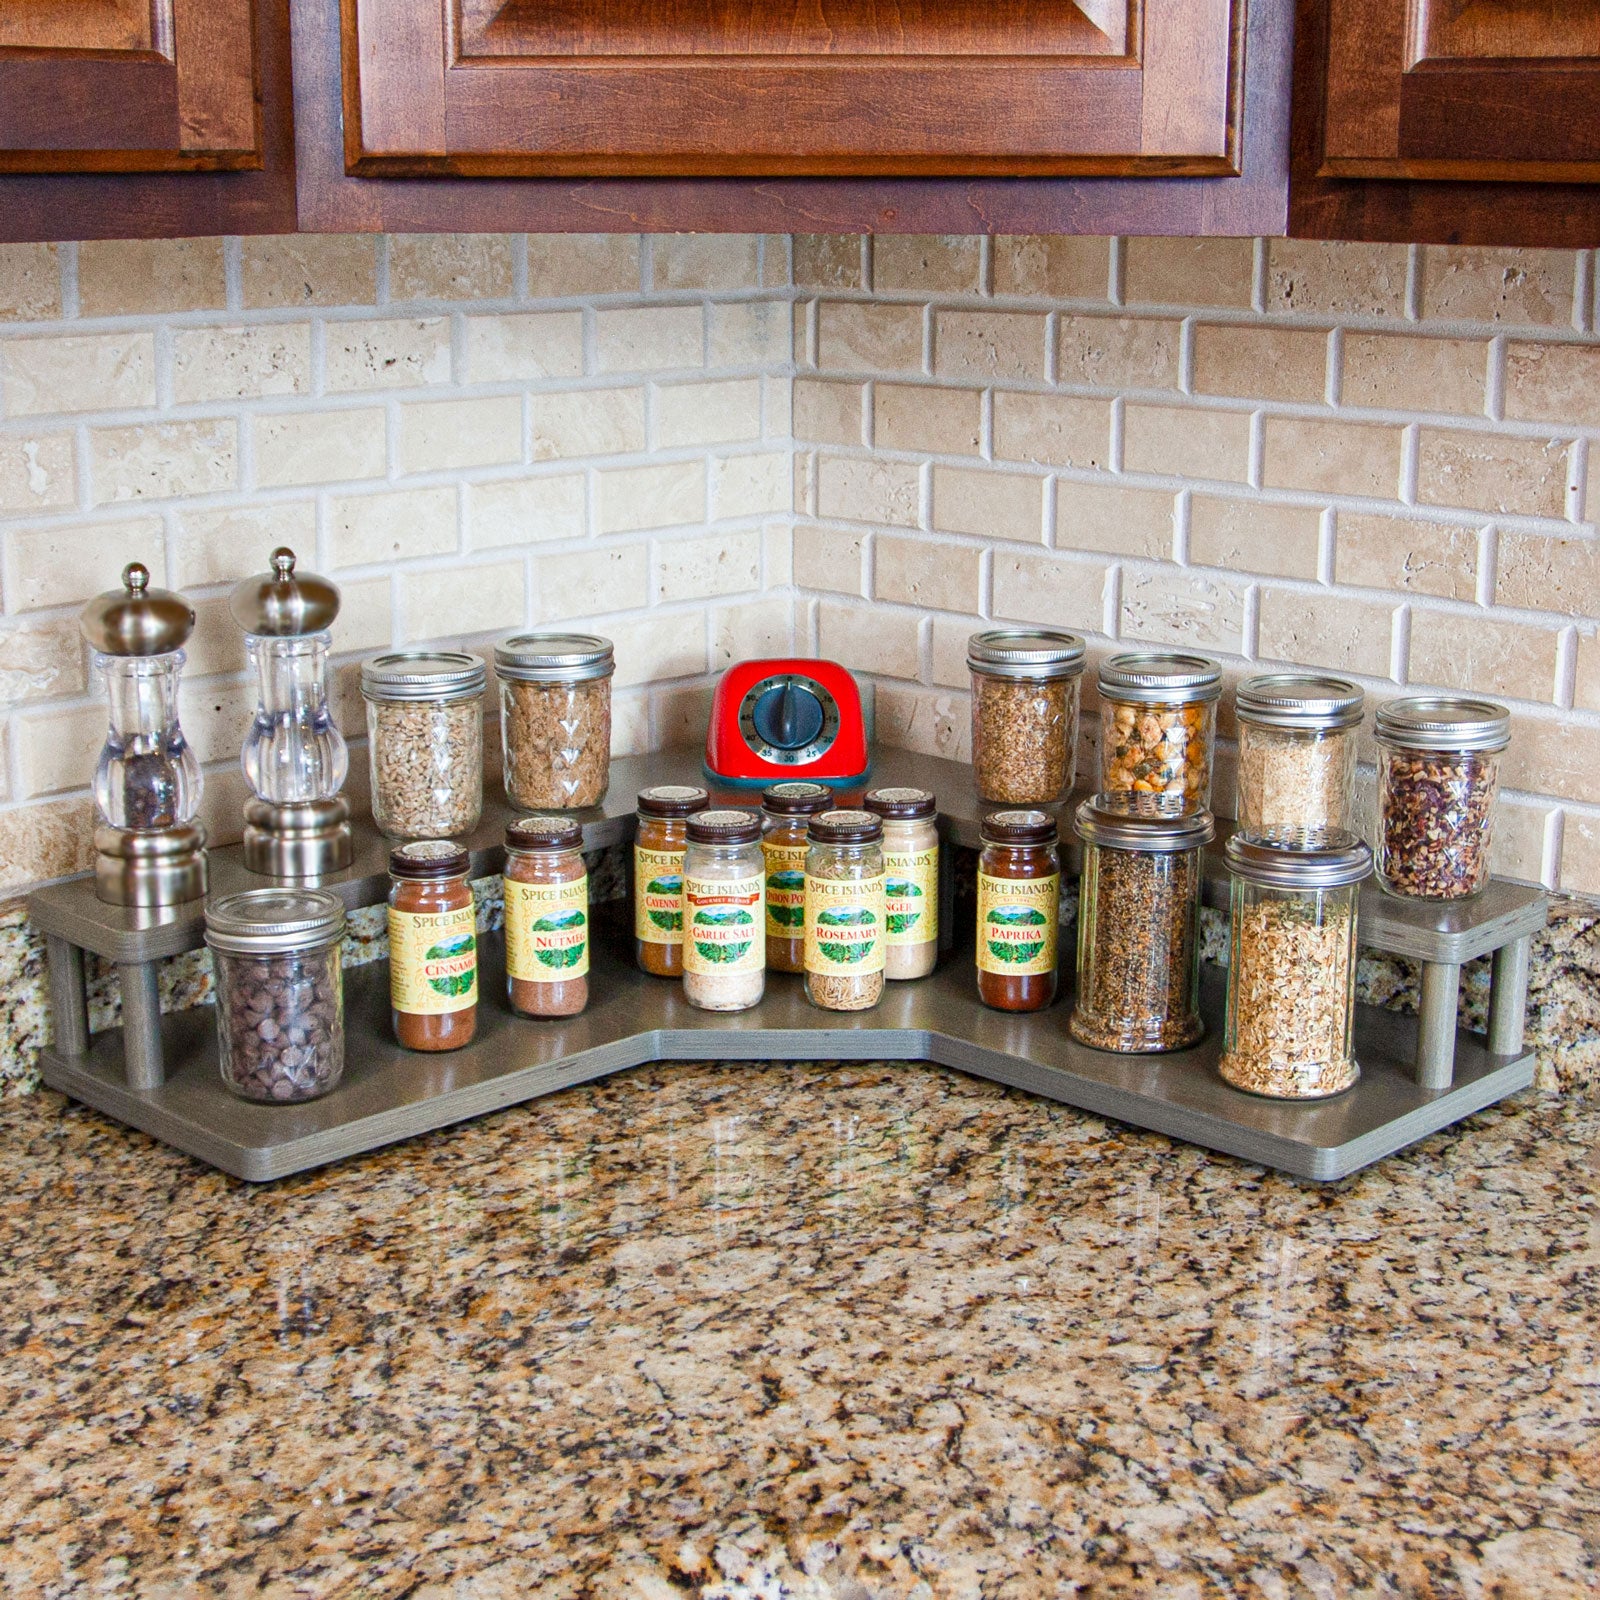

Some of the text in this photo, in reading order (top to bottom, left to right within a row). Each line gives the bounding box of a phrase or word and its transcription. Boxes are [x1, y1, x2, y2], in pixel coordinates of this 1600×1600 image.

[761, 749, 773, 757] 35
[784, 755, 795, 763] 30
[806, 750, 817, 758] 25
[640, 850, 666, 865] SPICE
[886, 853, 931, 867] ISLANDS
[686, 879, 760, 895] SPICE ISLANDS
[810, 880, 883, 895] SPICE ISLANDS
[981, 878, 1054, 895] SPICE ISLANDS
[521, 888, 556, 901] SPICE
[645, 896, 680, 909] CAYENNE
[413, 915, 450, 929] SPICE
[692, 926, 730, 940] GARLIC
[733, 927, 755, 939] SALT
[816, 926, 877, 940] ROSEMARY
[991, 927, 1042, 940] PAPRIKA
[536, 934, 586, 948] NUTMEG
